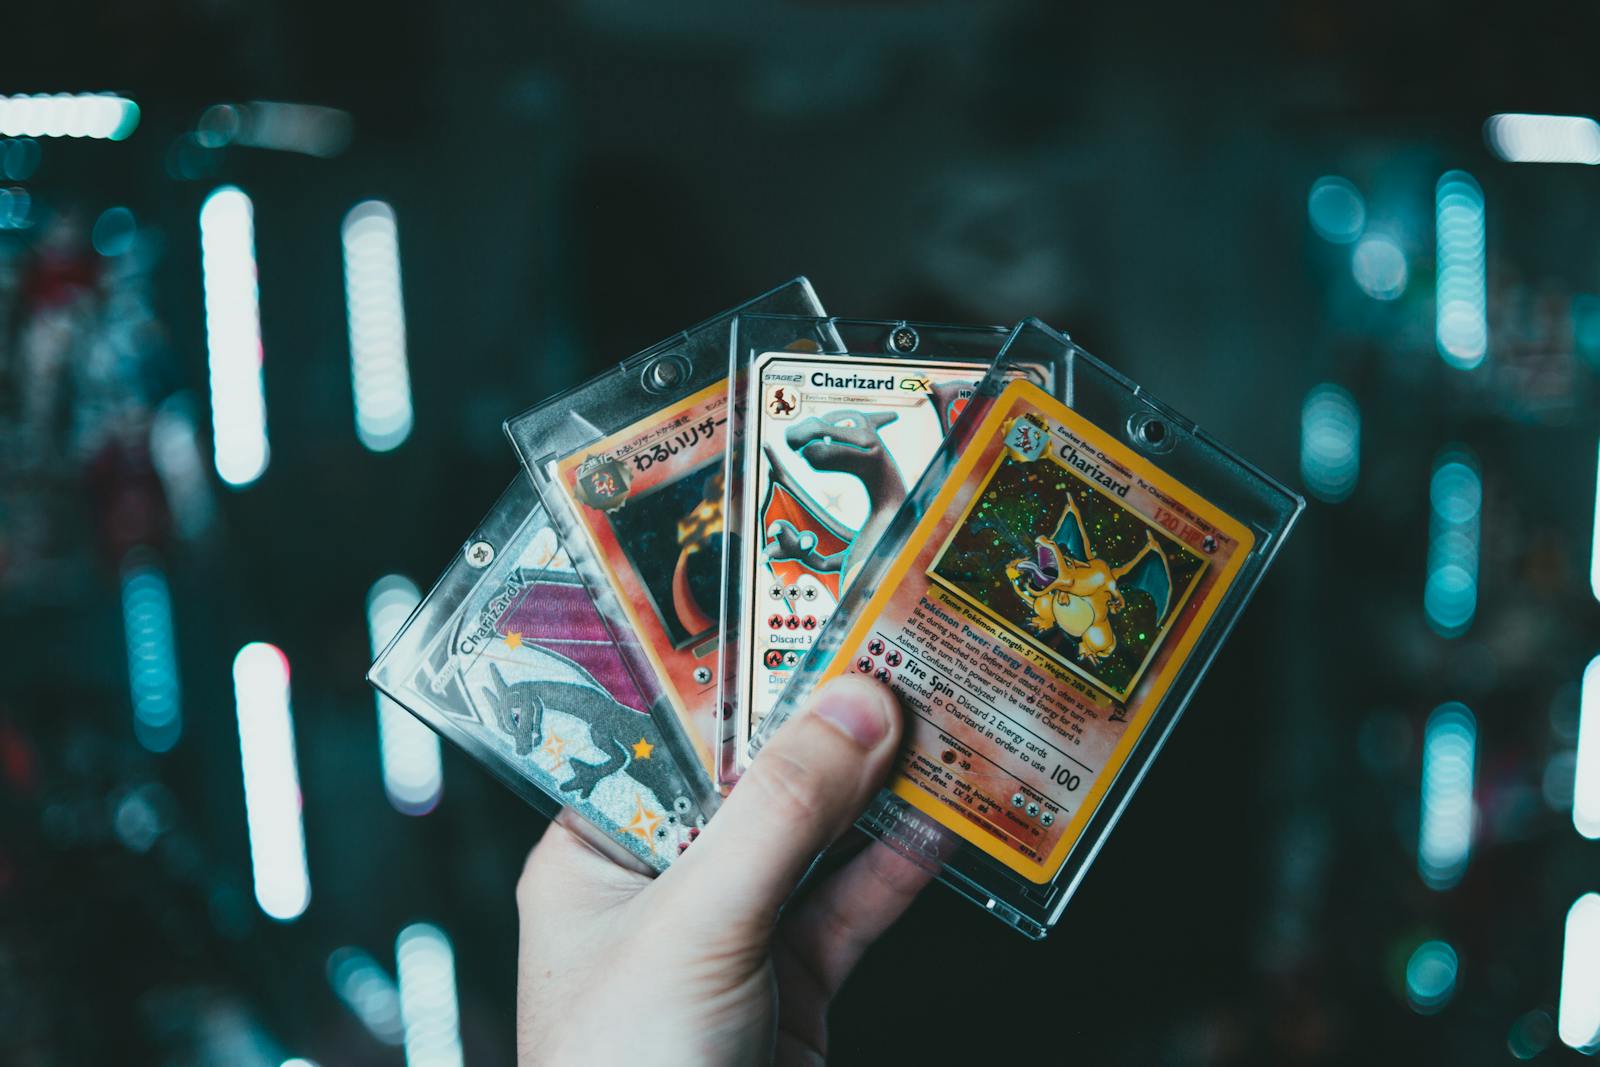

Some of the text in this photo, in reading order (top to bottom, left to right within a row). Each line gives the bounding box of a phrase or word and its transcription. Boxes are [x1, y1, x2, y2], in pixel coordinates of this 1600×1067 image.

[810, 372, 929, 392] Charizard GX
[958, 389, 971, 399] HP
[1057, 426, 1080, 444] Evolves
[1079, 441, 1095, 454] from
[1059, 444, 1131, 497] Charizard
[1152, 507, 1202, 547] 120 HP
[460, 583, 519, 656] Charizard
[770, 634, 812, 644] Discard 3
[961, 608, 996, 635] Pokémon.
[997, 631, 1024, 652] Length:
[895, 634, 919, 654] Asleep,
[921, 650, 953, 676] Confused,
[963, 677, 996, 703] Paralyzed.
[906, 617, 1083, 734] all Energy attached to Charizard into Energy for the
[912, 606, 925, 619] like
[926, 616, 948, 635] during
[946, 631, 964, 644] your
[964, 642, 980, 655] turn
[979, 651, 1002, 670] (before
[1001, 667, 1018, 679] your
[1040, 692, 1055, 703] you
[1055, 701, 1069, 713] may
[1070, 710, 1085, 723] turn
[918, 596, 1098, 719] Pokémon Power: Energy Burn As often as you
[901, 626, 916, 638] rest
[925, 641, 936, 652] the
[937, 649, 952, 663] turn.
[954, 657, 968, 672] This
[967, 670, 991, 686] power
[991, 685, 1008, 698] can't
[1008, 694, 1017, 704] be
[1018, 702, 1035, 715] used
[1034, 711, 1042, 719] if
[1041, 715, 1074, 741] Charizard
[1073, 737, 1080, 745] is
[906, 695, 932, 716] attack.
[897, 673, 1045, 772] attached to Charizard in order to use
[904, 659, 1047, 758] Fire Spin Discard 2 Energy cards
[938, 731, 972, 757] resistance
[958, 759, 971, 770] -30
[909, 760, 931, 777] forest
[930, 774, 947, 788] fires.
[1050, 764, 1080, 791] 100
[916, 755, 943, 775] enough
[944, 772, 952, 780] to
[954, 779, 971, 792] melt
[1030, 827, 1039, 836] to
[1018, 785, 1059, 814] retreat cost
